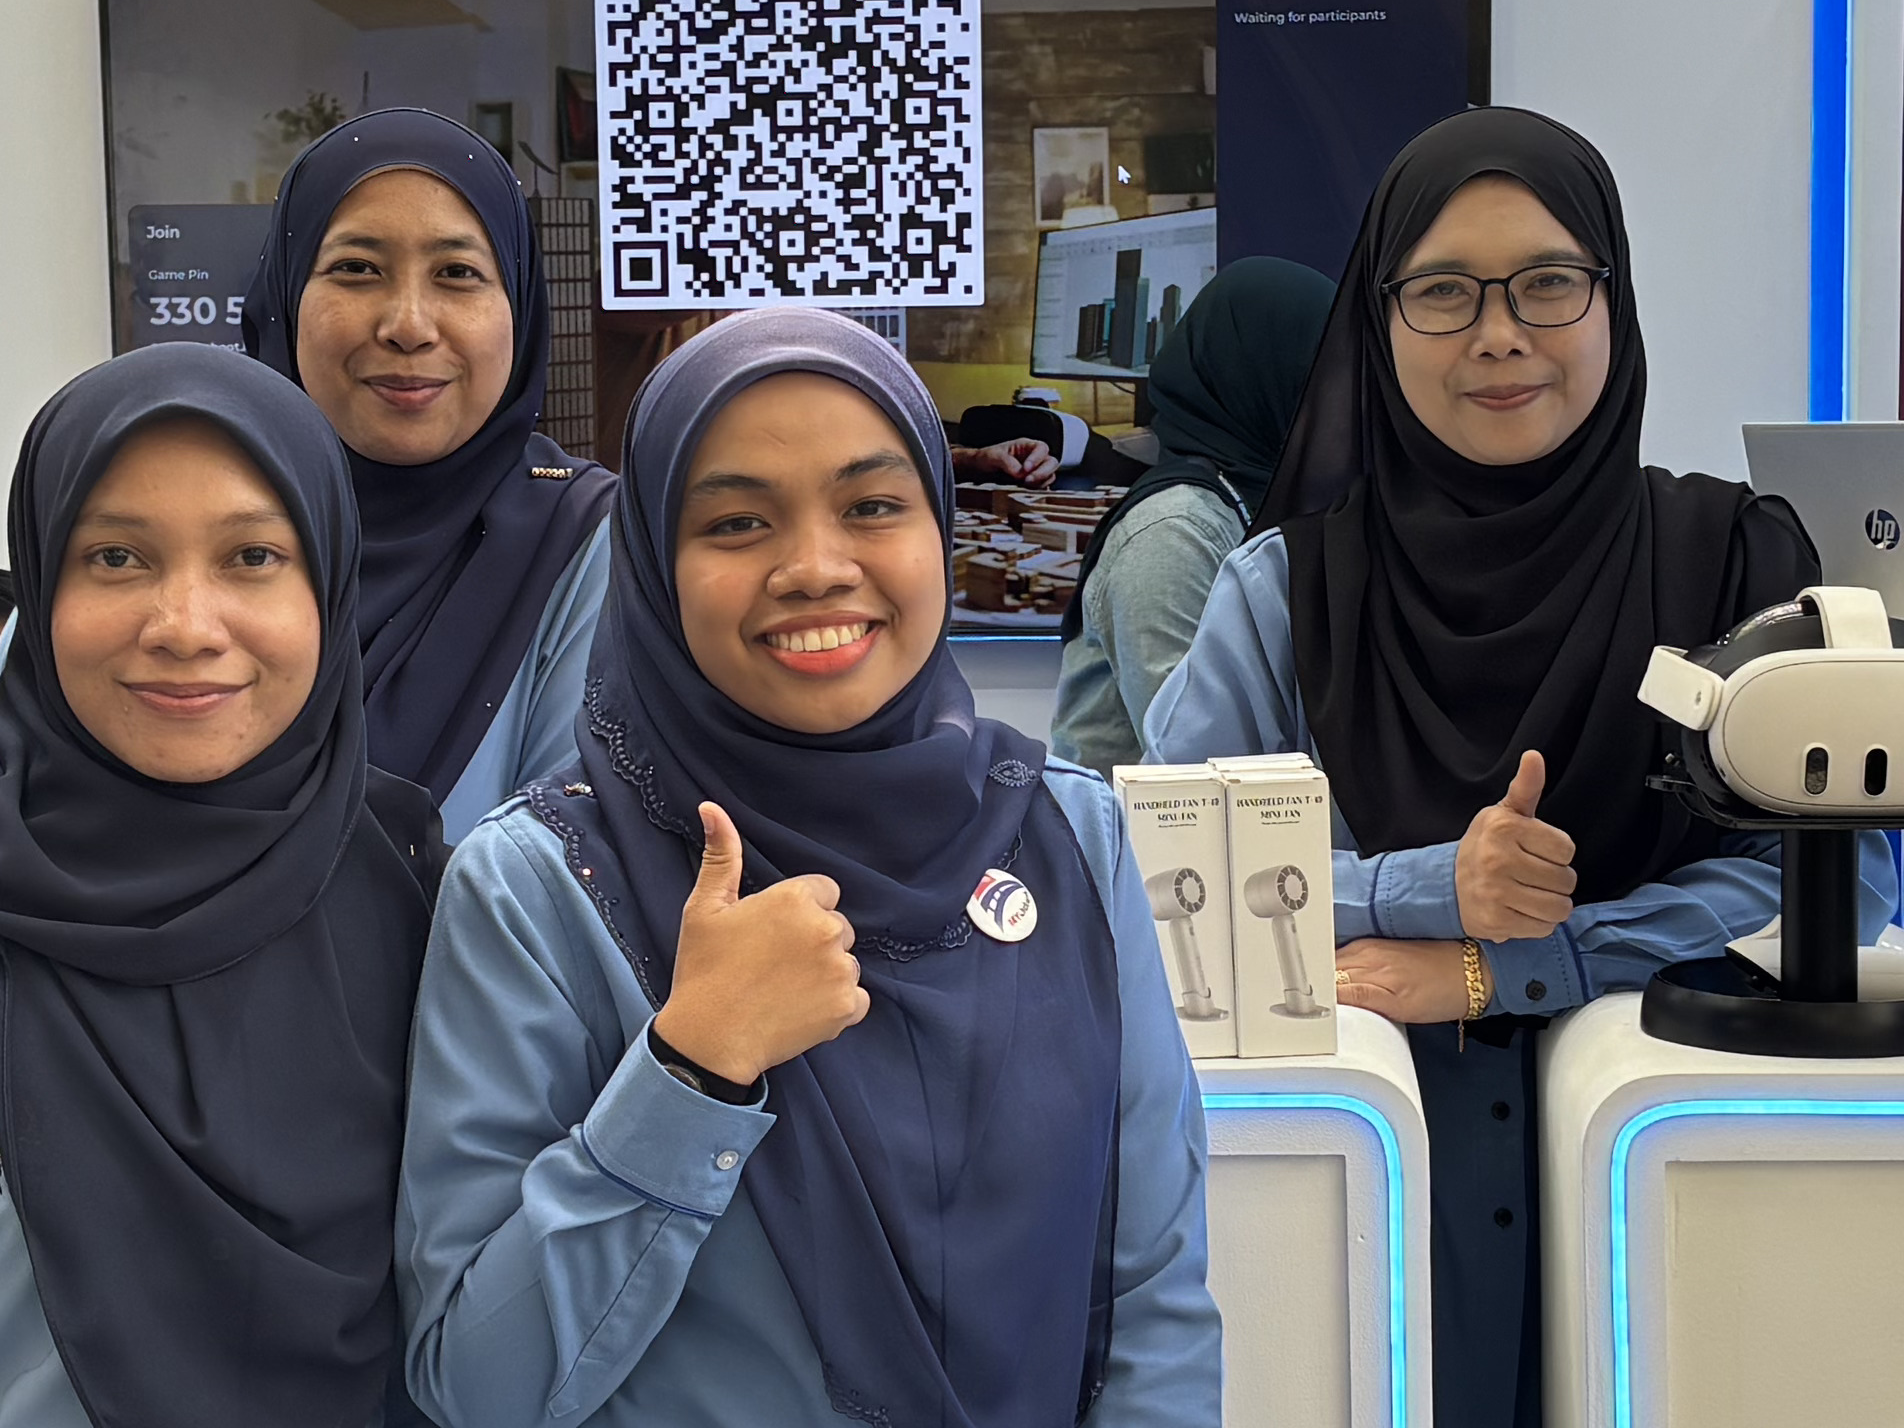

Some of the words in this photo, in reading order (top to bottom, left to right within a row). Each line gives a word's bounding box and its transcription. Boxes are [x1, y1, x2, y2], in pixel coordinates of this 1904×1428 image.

[1234, 13, 1285, 25] Waiting
[1288, 12, 1306, 23] for
[1309, 9, 1387, 24] participants
[146, 225, 180, 239] Join
[148, 270, 185, 280] Game
[188, 269, 209, 280] Pin
[149, 296, 217, 325] 330
[1869, 509, 1897, 551] hp
